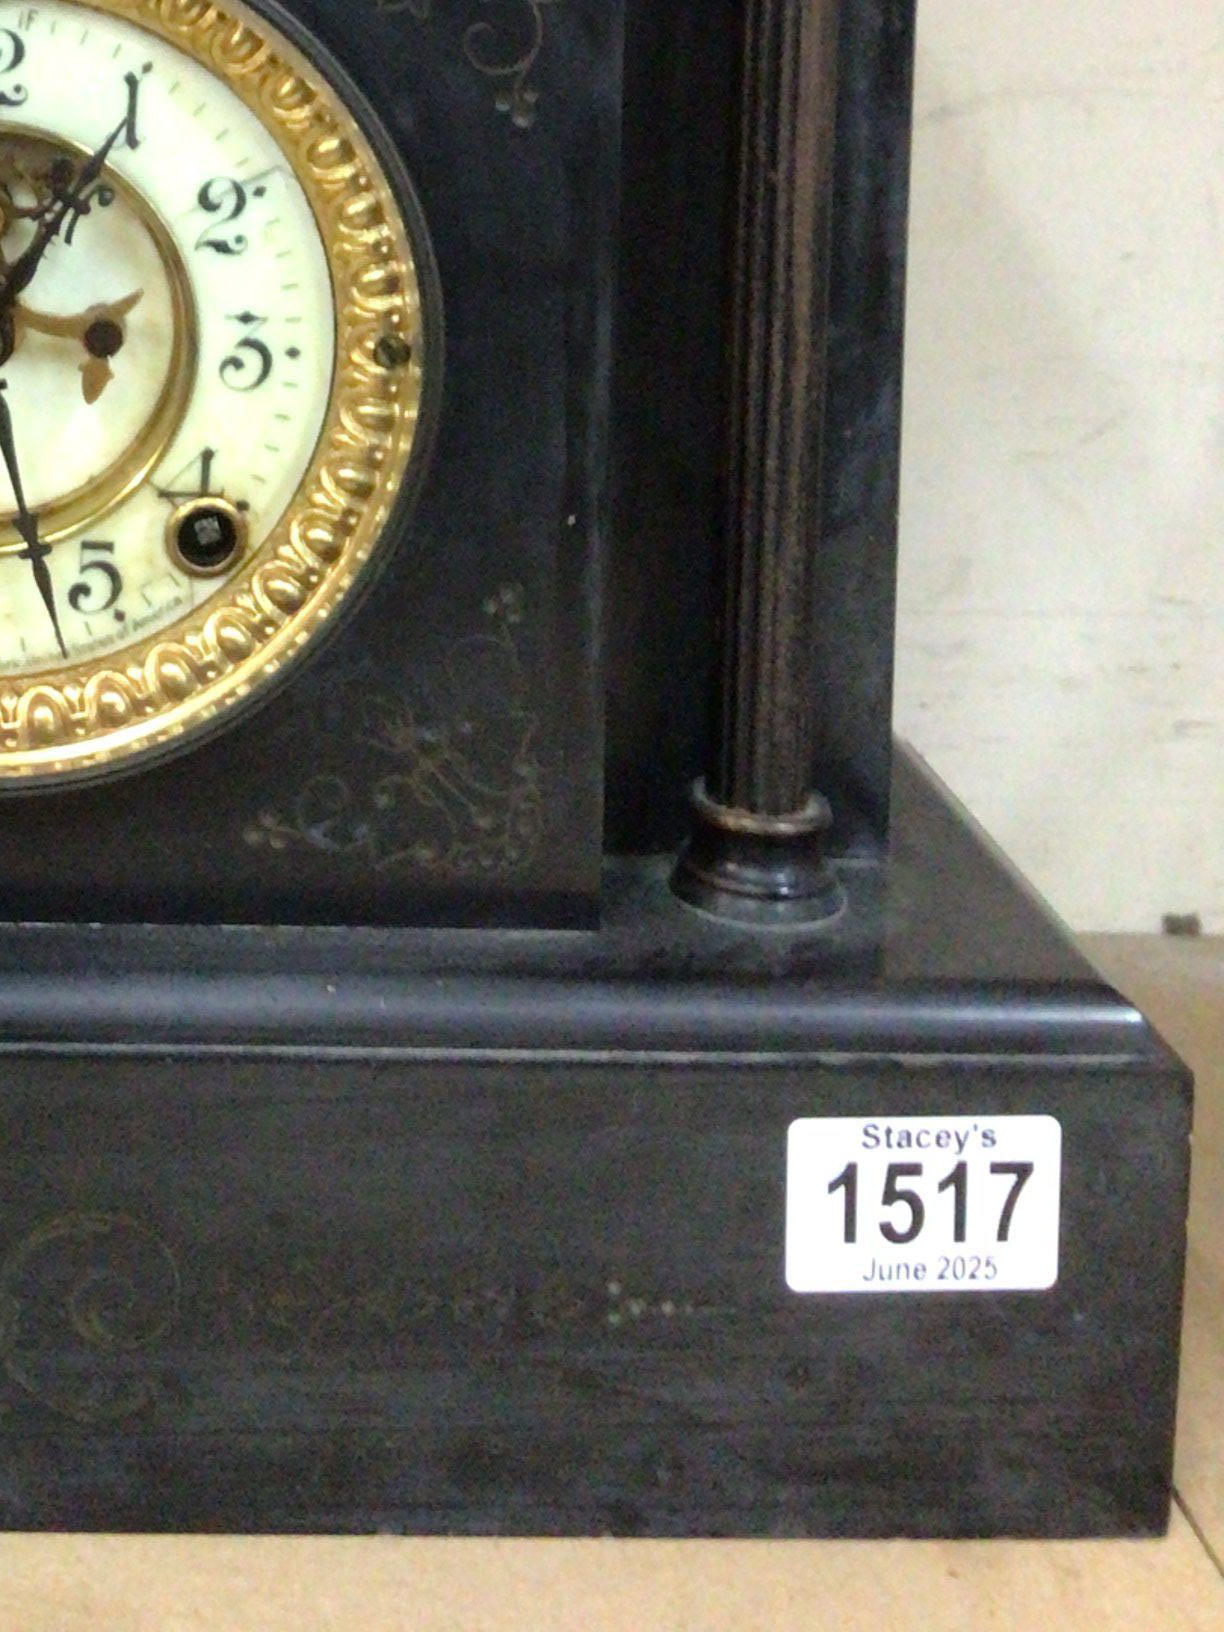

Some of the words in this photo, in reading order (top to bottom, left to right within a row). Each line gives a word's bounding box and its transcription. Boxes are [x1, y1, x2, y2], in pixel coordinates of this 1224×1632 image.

[196, 176, 248, 254] 2
[219, 310, 273, 392] 3
[68, 541, 123, 612] 5
[862, 1123, 997, 1155] Stacey's
[828, 1161, 1034, 1244] 1517
[862, 1257, 927, 1282] June
[937, 1255, 999, 1280] 2025
